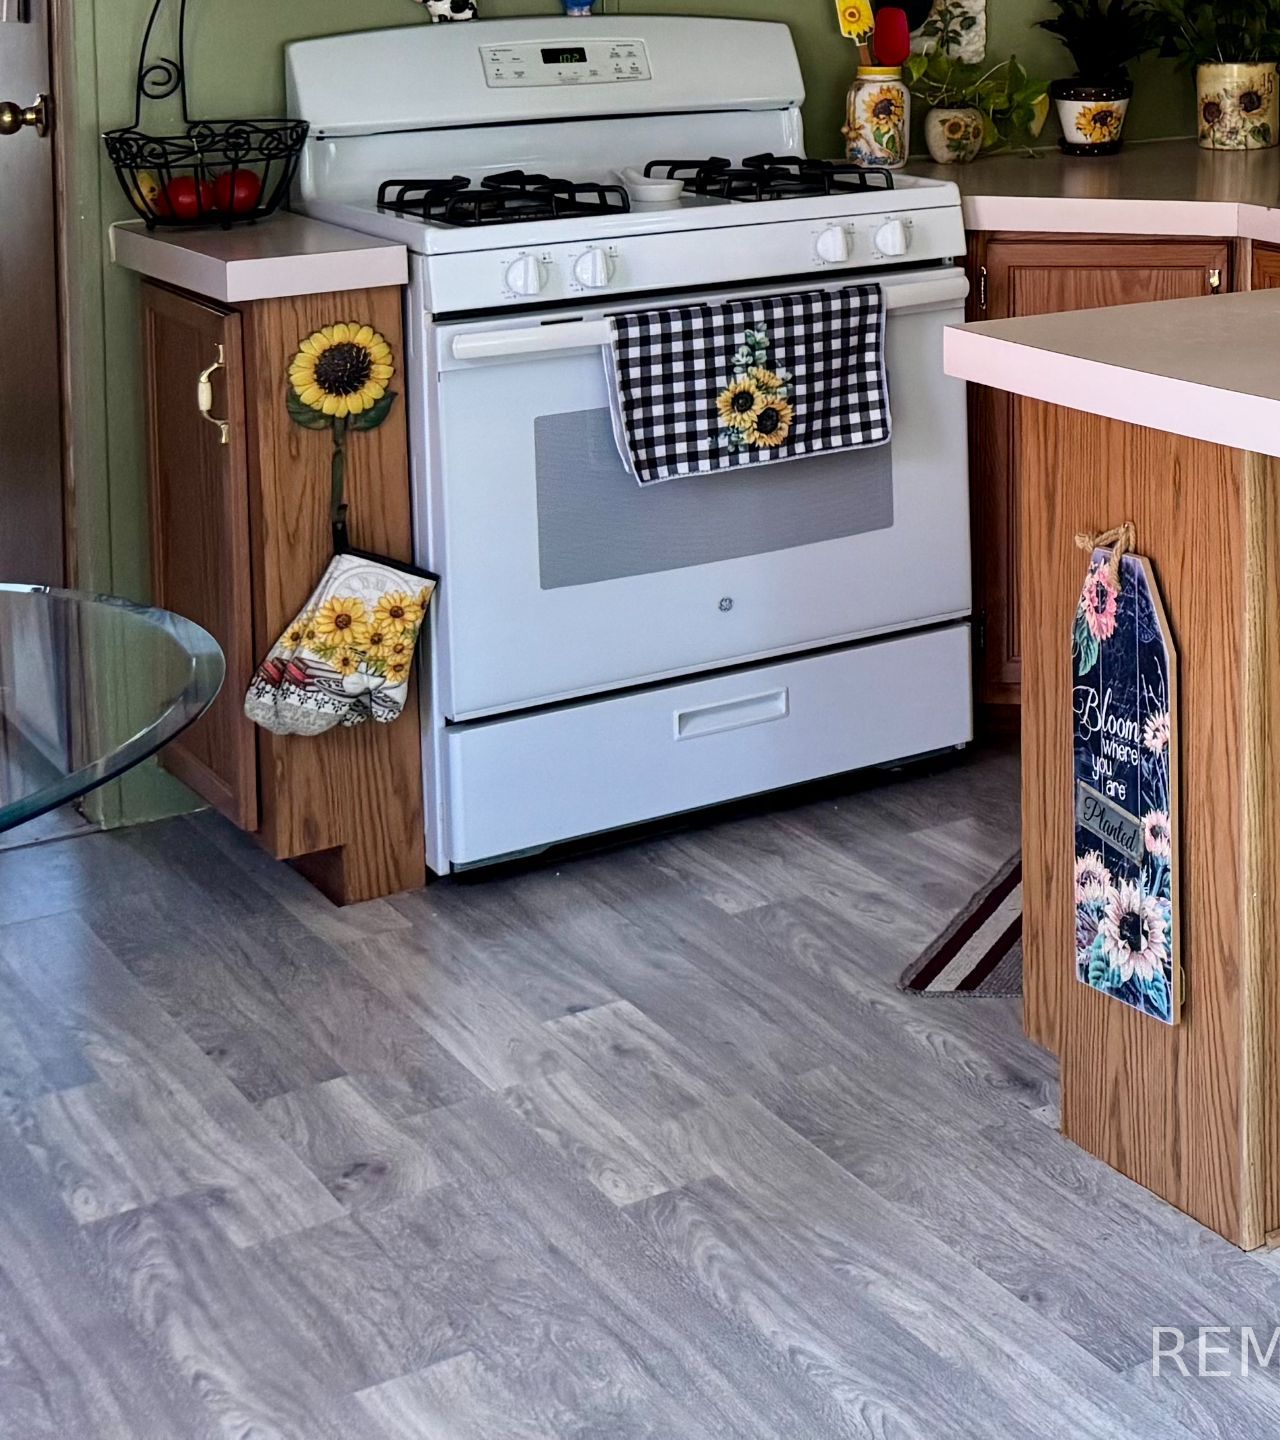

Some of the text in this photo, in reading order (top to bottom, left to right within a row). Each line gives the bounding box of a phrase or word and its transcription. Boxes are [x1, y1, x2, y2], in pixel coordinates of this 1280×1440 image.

[1072, 684, 1141, 742] Bloom
[1102, 738, 1139, 766] where
[1091, 753, 1113, 780] you
[1106, 779, 1127, 801] are
[1083, 796, 1138, 852] Planted
